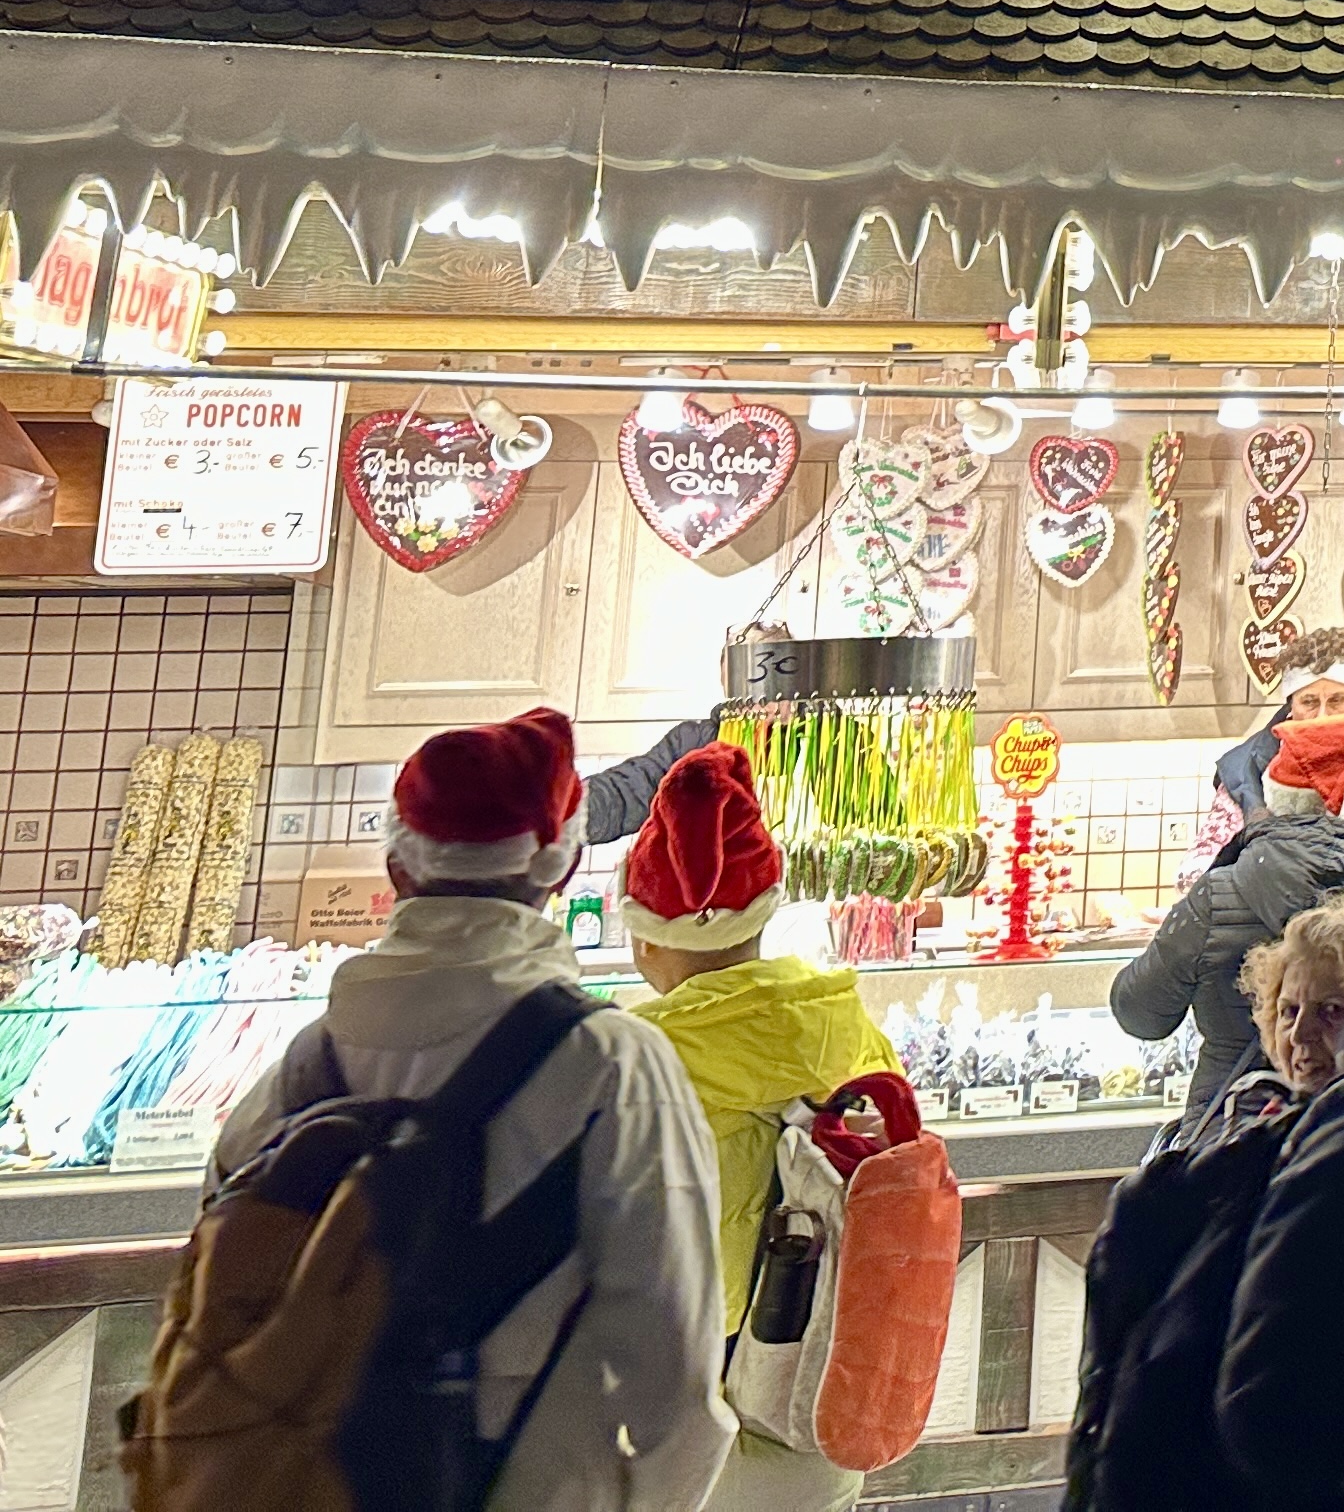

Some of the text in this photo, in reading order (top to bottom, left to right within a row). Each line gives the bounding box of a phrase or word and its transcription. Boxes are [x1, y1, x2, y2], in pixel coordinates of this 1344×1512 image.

[186, 404, 302, 428] POPCORN
[121, 438, 252, 447] mit Zucker oder Salz
[164, 454, 180, 469] €
[269, 454, 284, 469] €
[362, 448, 487, 479] Ich denke
[649, 441, 773, 475] Ich liebe
[666, 471, 739, 497] Dich
[156, 523, 172, 539] €
[261, 522, 276, 537] €
[1001, 754, 1049, 784] Chups
[310, 918, 372, 928] Waffelfabrik
